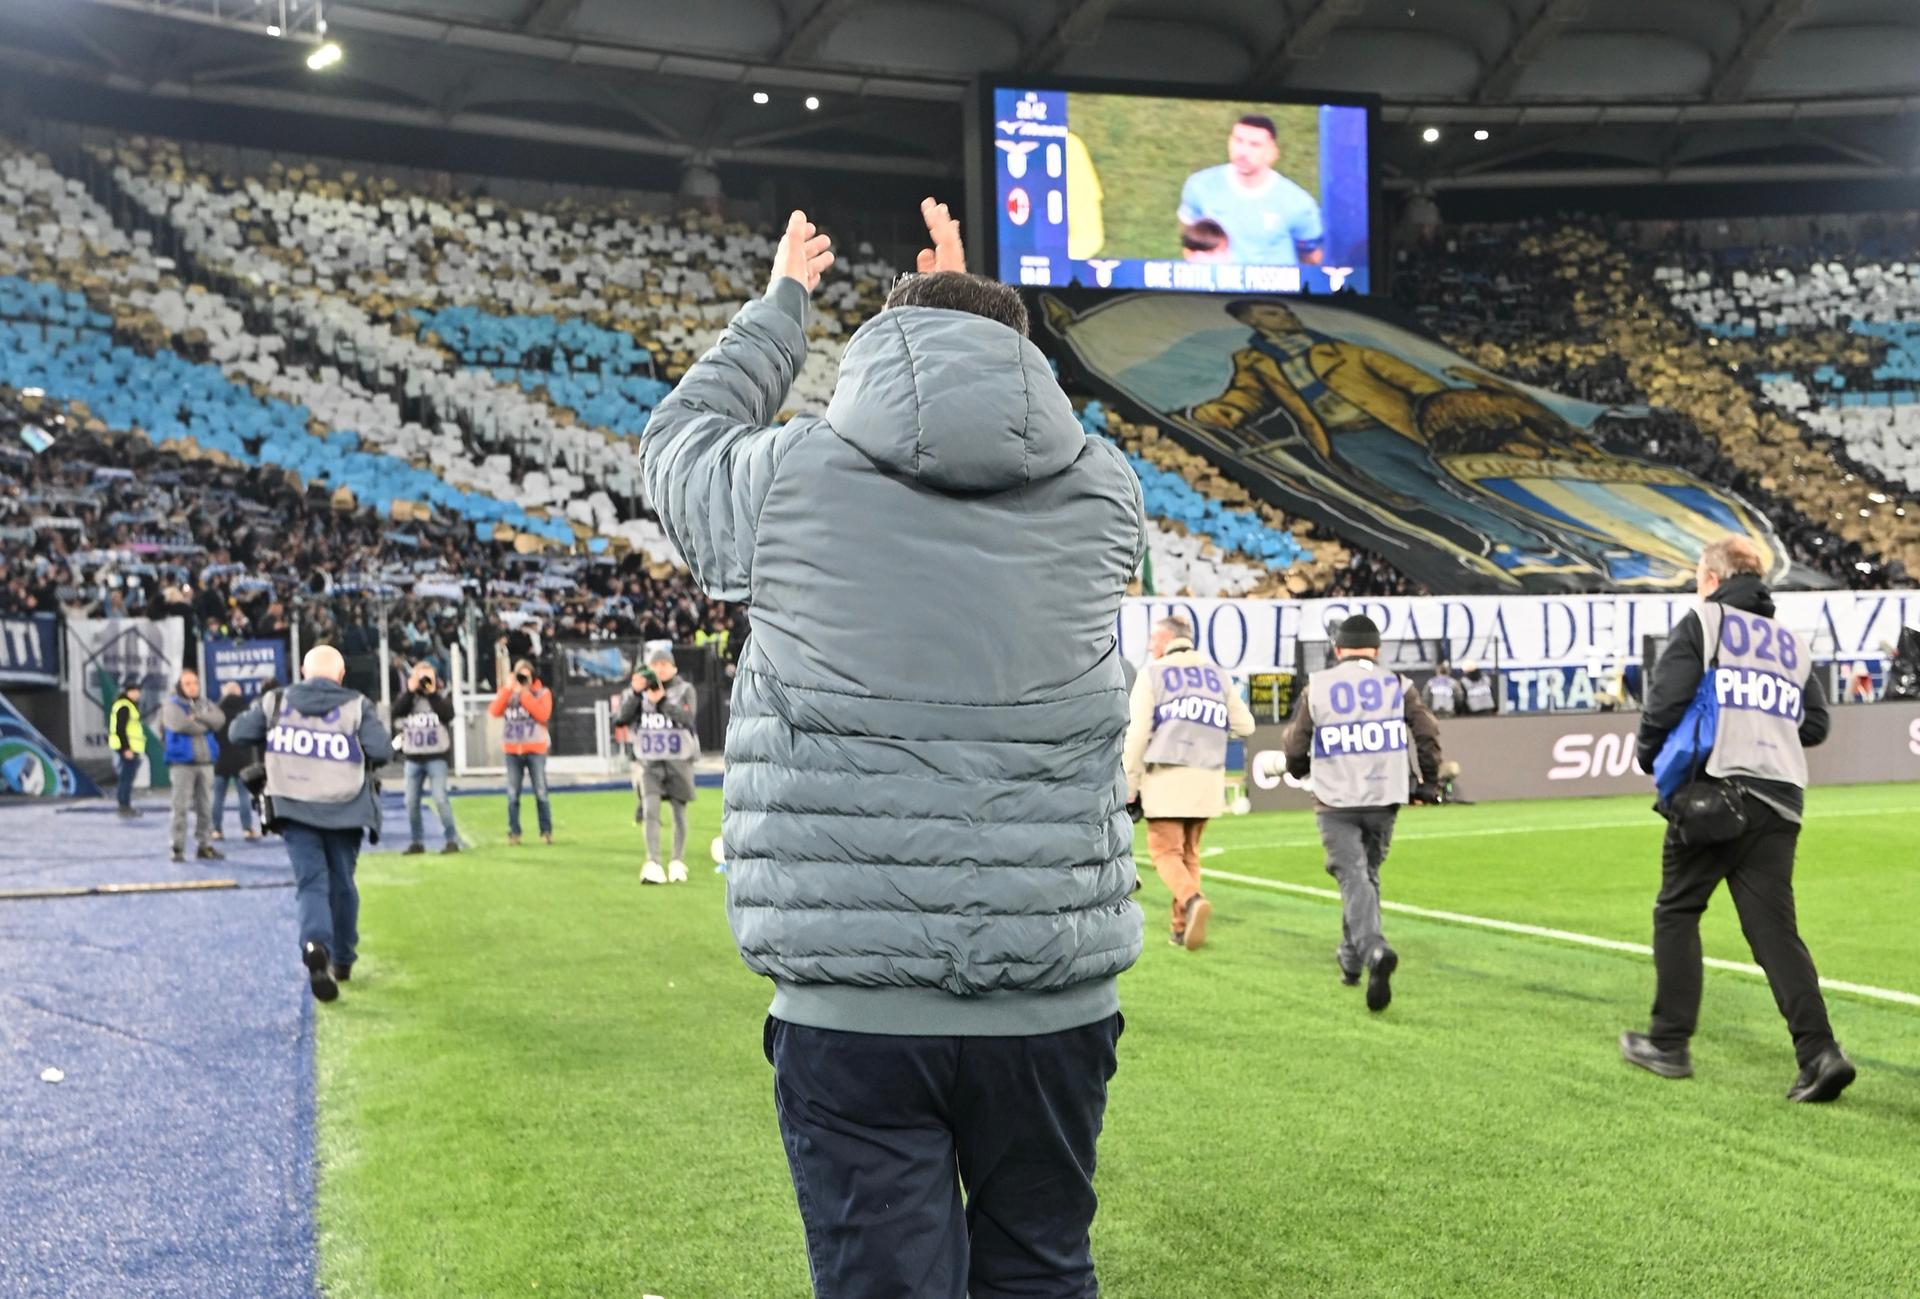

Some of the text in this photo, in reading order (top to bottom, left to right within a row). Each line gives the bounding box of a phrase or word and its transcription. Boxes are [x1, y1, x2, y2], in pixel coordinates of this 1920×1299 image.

[1721, 614, 1798, 671] 028
[1162, 666, 1222, 693] 096
[1329, 676, 1403, 715] 097
[1547, 731, 1647, 780] SN
